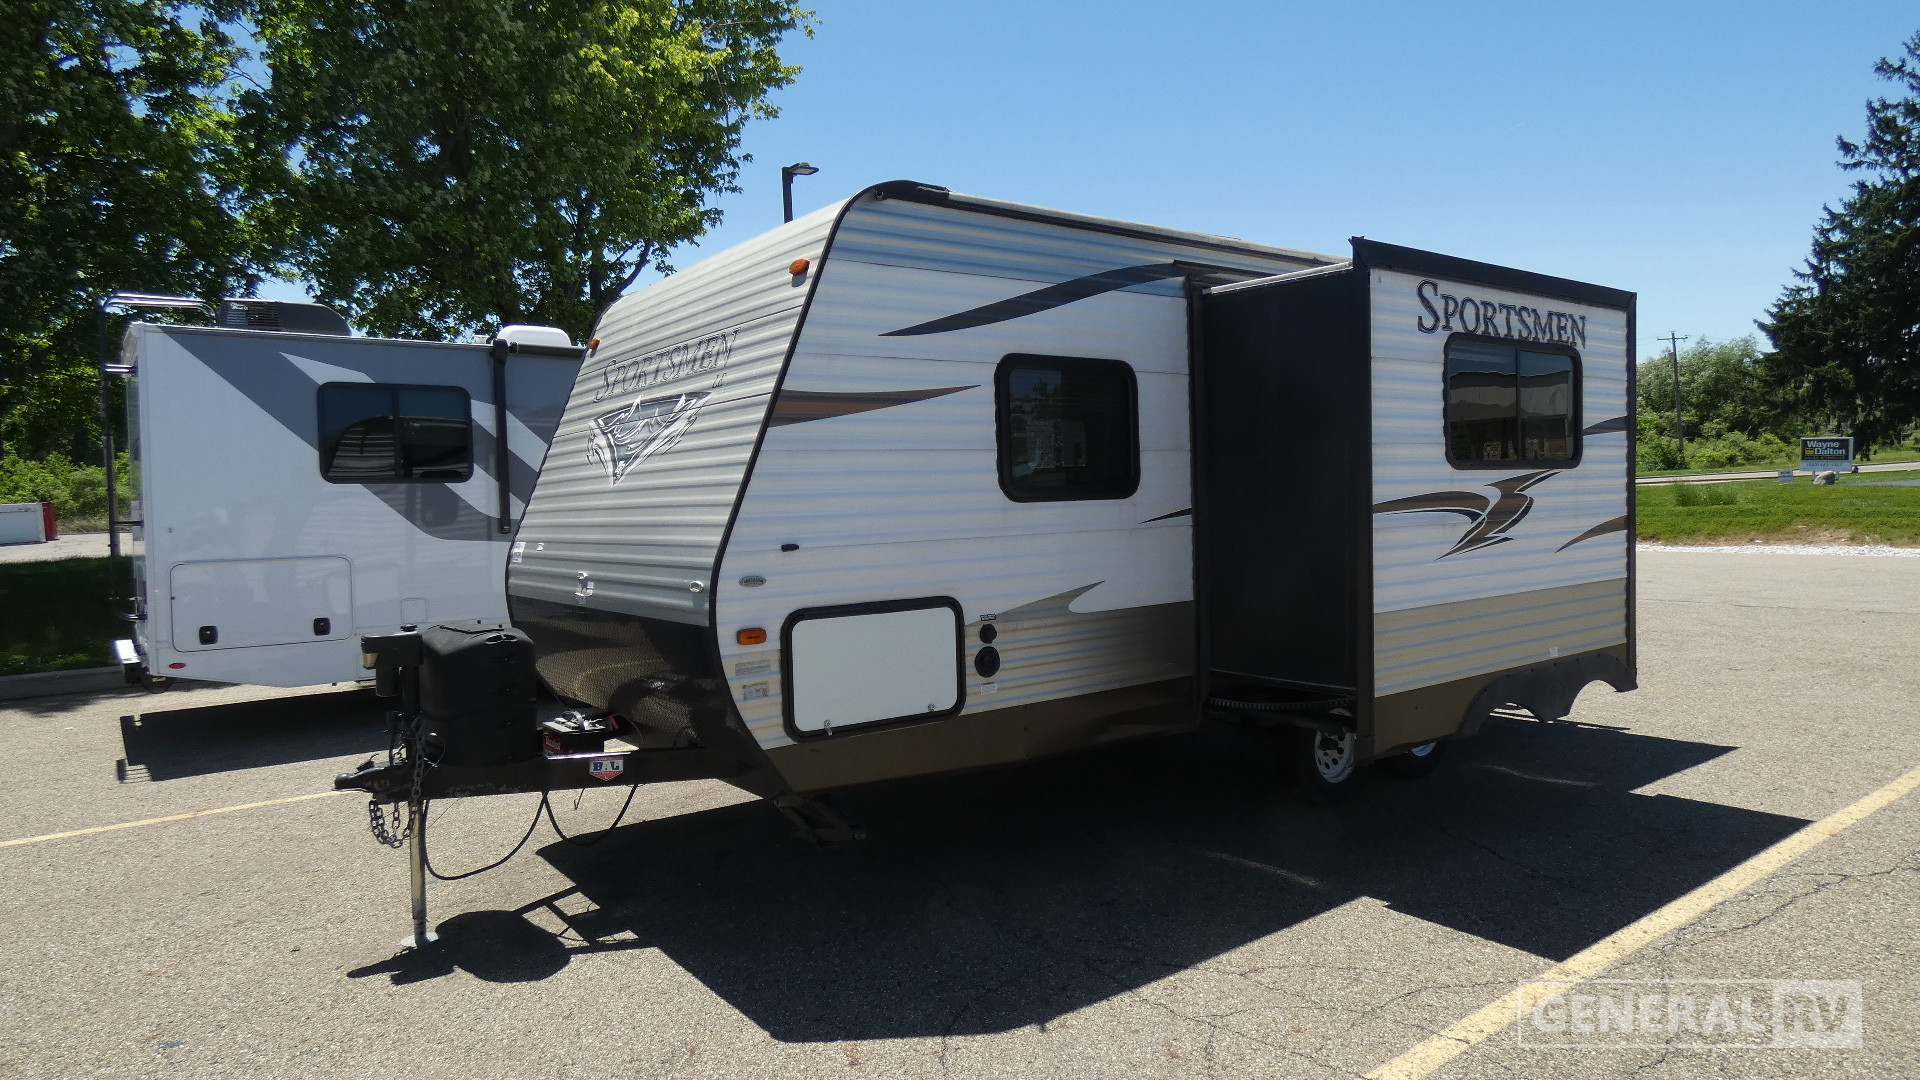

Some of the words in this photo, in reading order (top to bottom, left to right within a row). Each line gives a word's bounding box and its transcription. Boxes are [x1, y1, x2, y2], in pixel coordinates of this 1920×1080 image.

[1416, 279, 1587, 349] SPORTSMEN
[593, 327, 741, 403] SPORTSMEN
[1806, 440, 1839, 449] Wayne
[1814, 447, 1846, 455] Dalton
